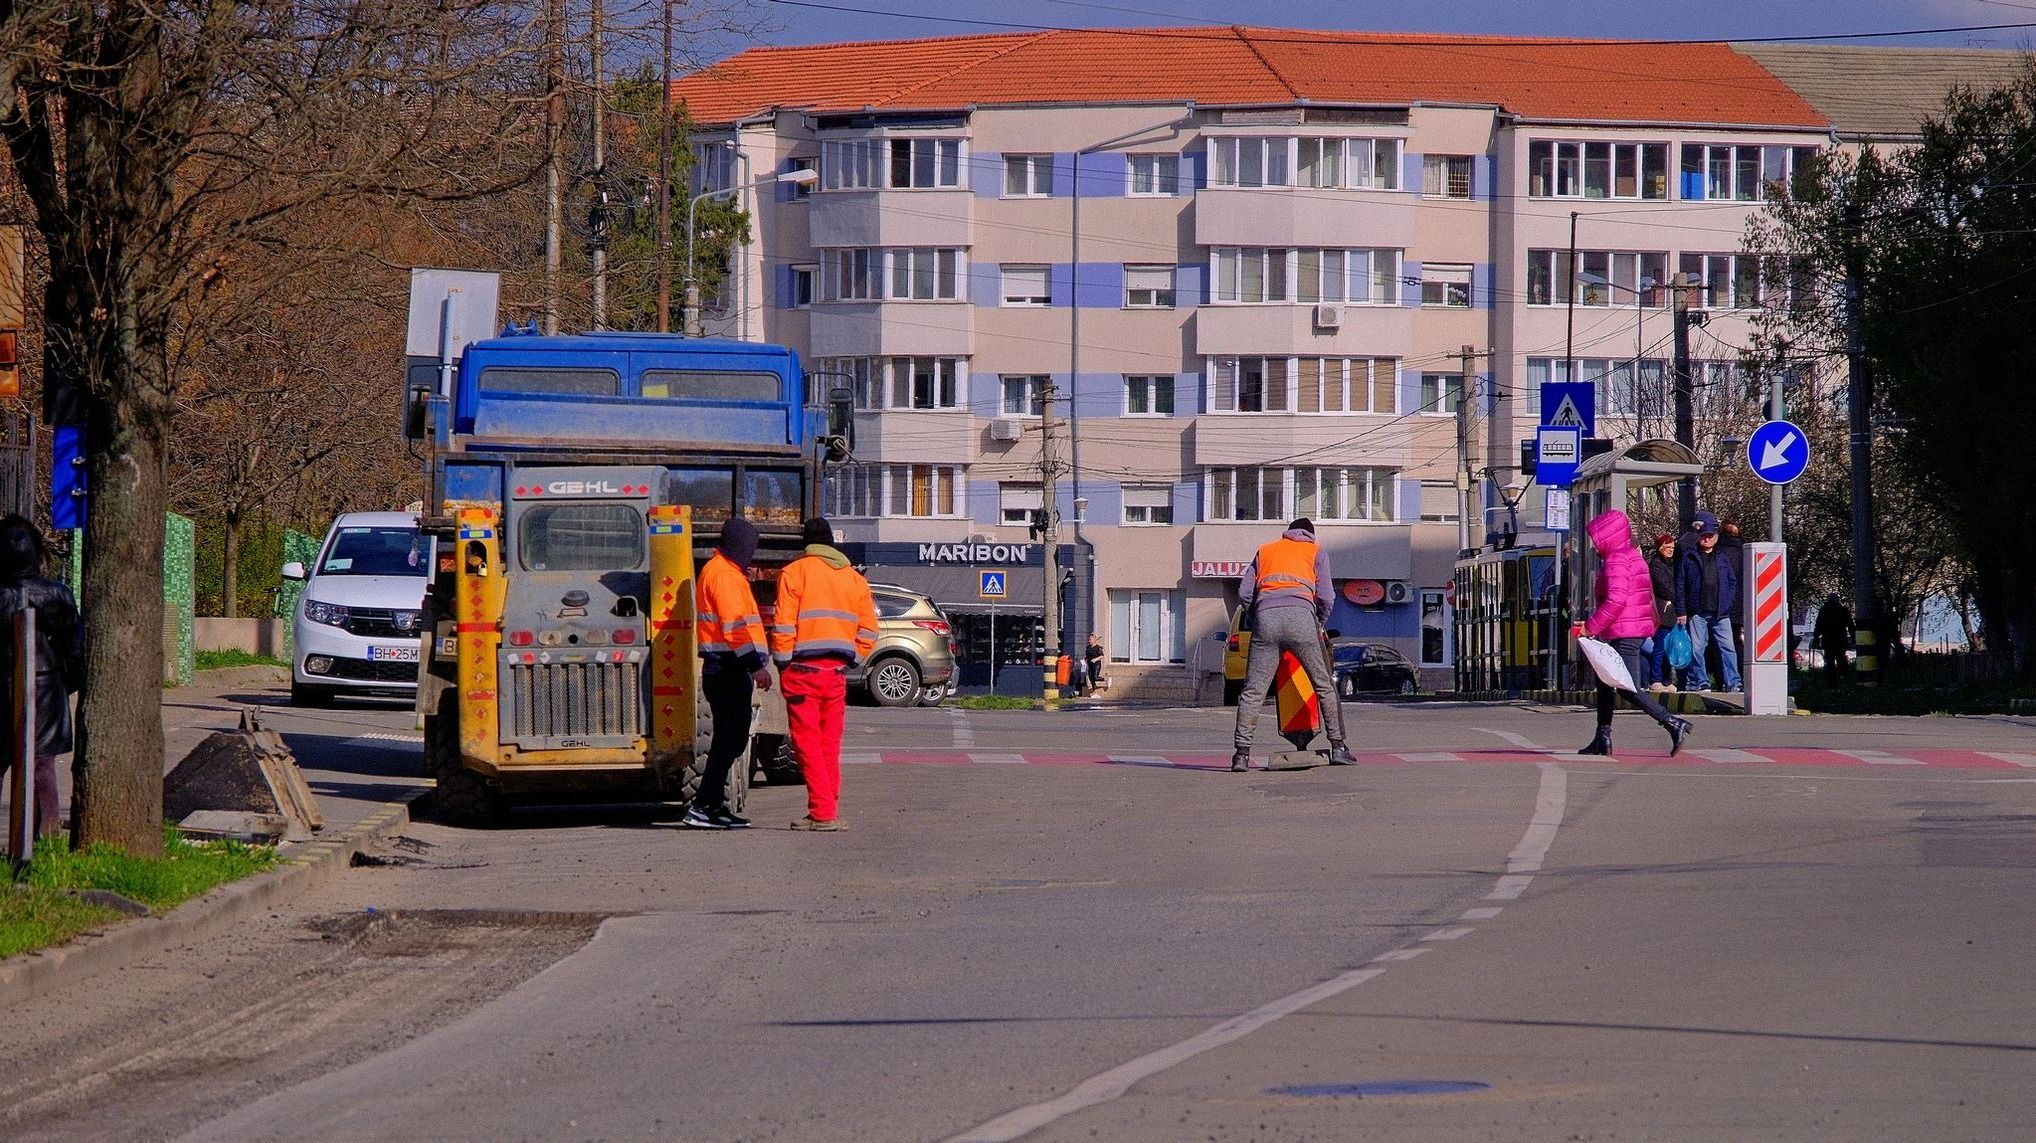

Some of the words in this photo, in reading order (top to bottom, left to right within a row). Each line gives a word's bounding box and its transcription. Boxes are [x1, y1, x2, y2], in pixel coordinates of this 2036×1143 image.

[548, 480, 618, 494] GEHL
[919, 543, 1026, 562] MARIBON
[375, 647, 391, 659] BH
[560, 740, 591, 748] GEHL
